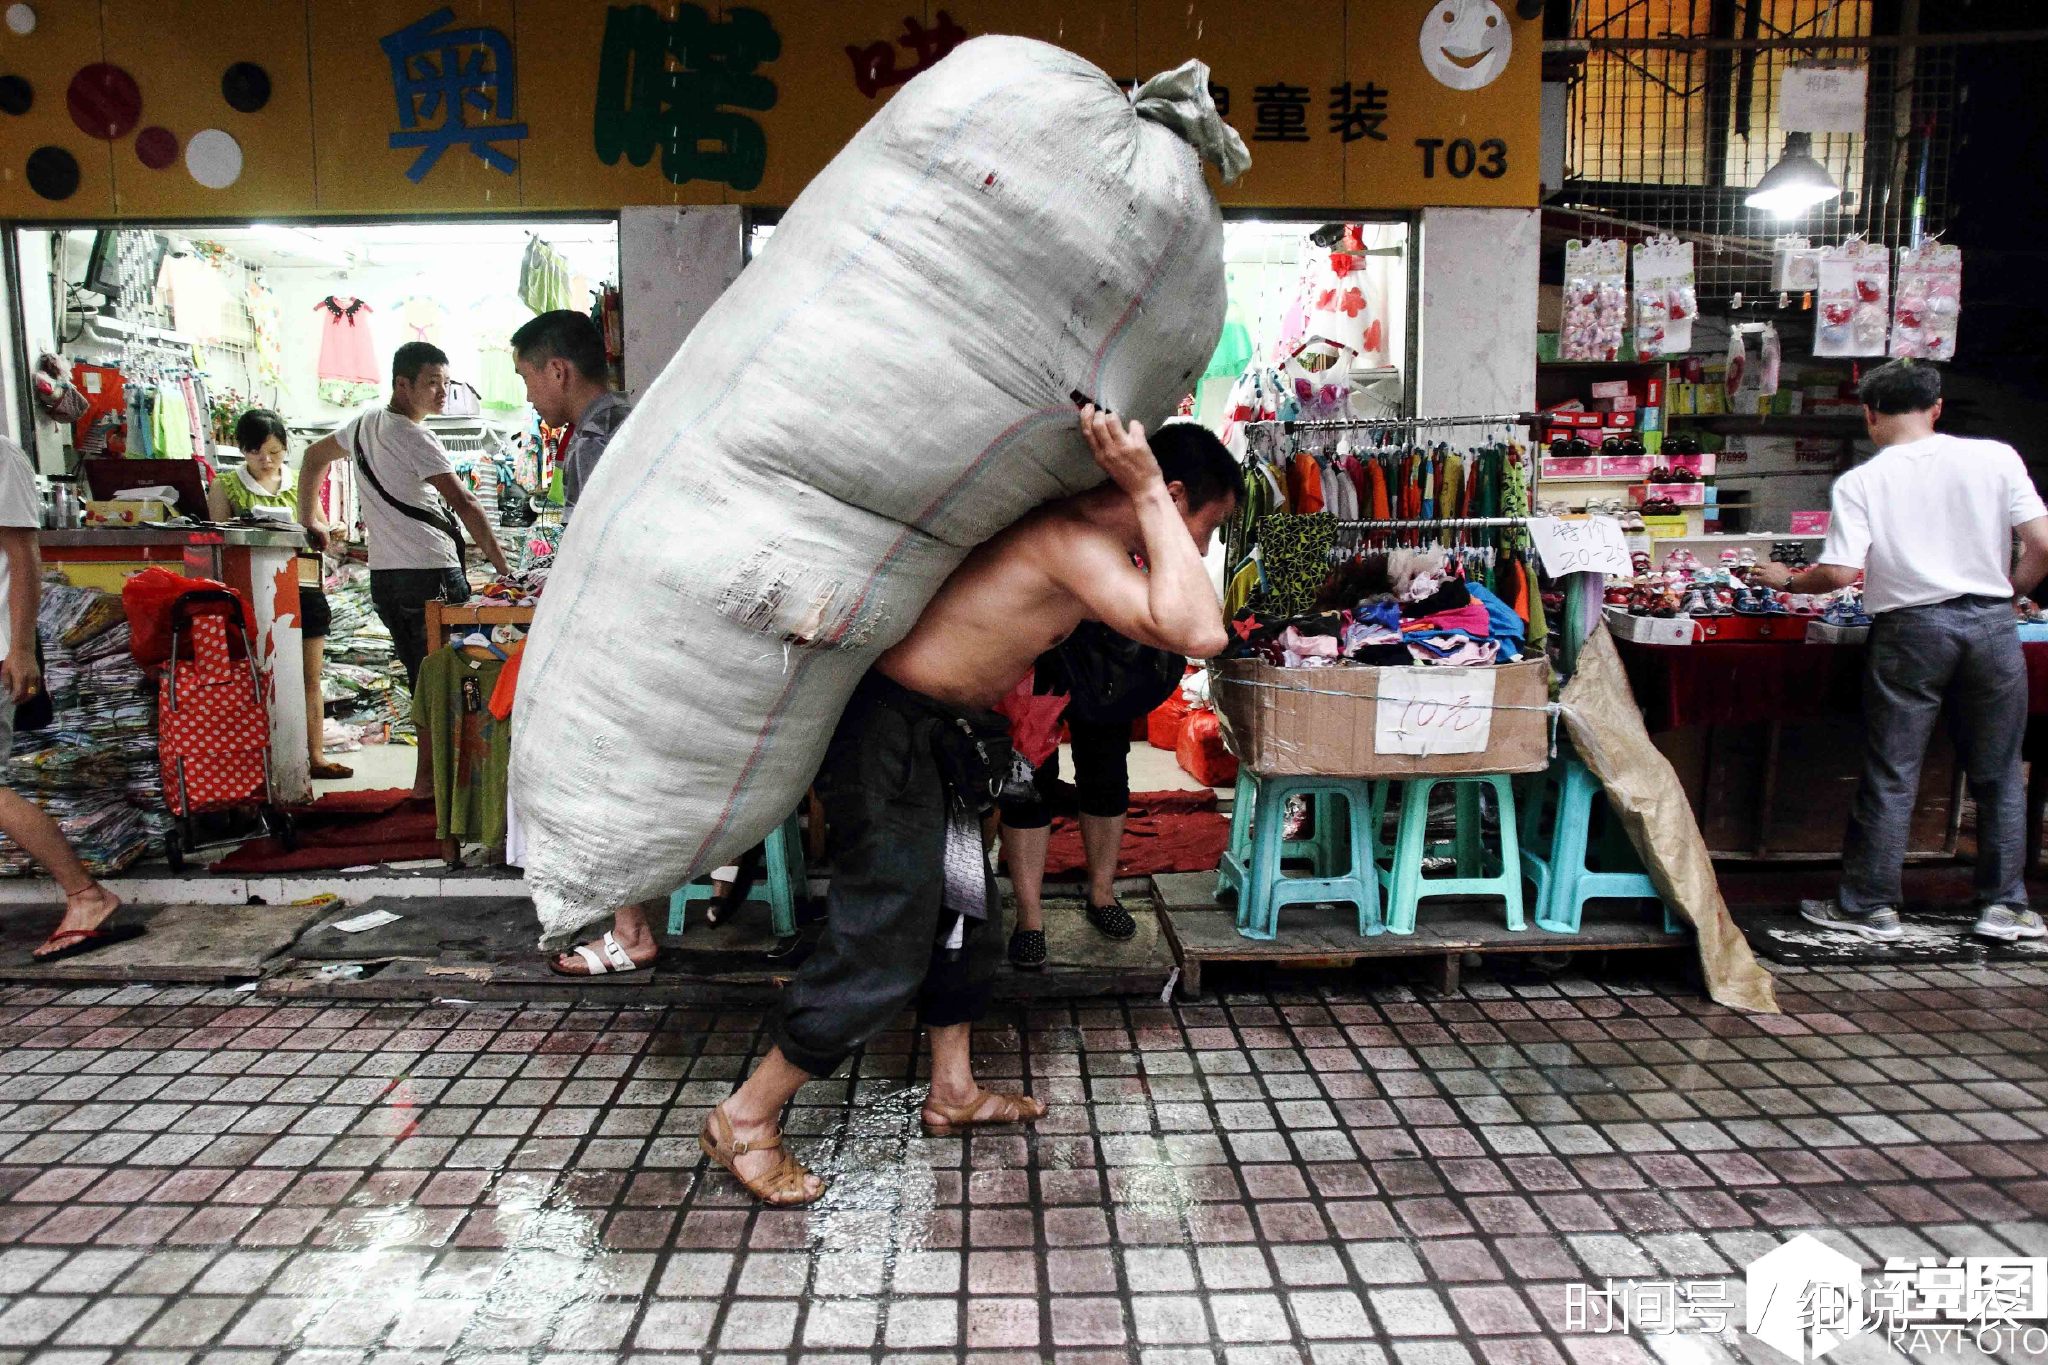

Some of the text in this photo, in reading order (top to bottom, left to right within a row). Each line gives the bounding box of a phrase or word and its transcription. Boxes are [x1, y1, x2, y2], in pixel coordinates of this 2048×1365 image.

[1415, 137, 1509, 179] T03
[1552, 519, 1608, 544] 特价
[1559, 545, 1626, 570] 20-25
